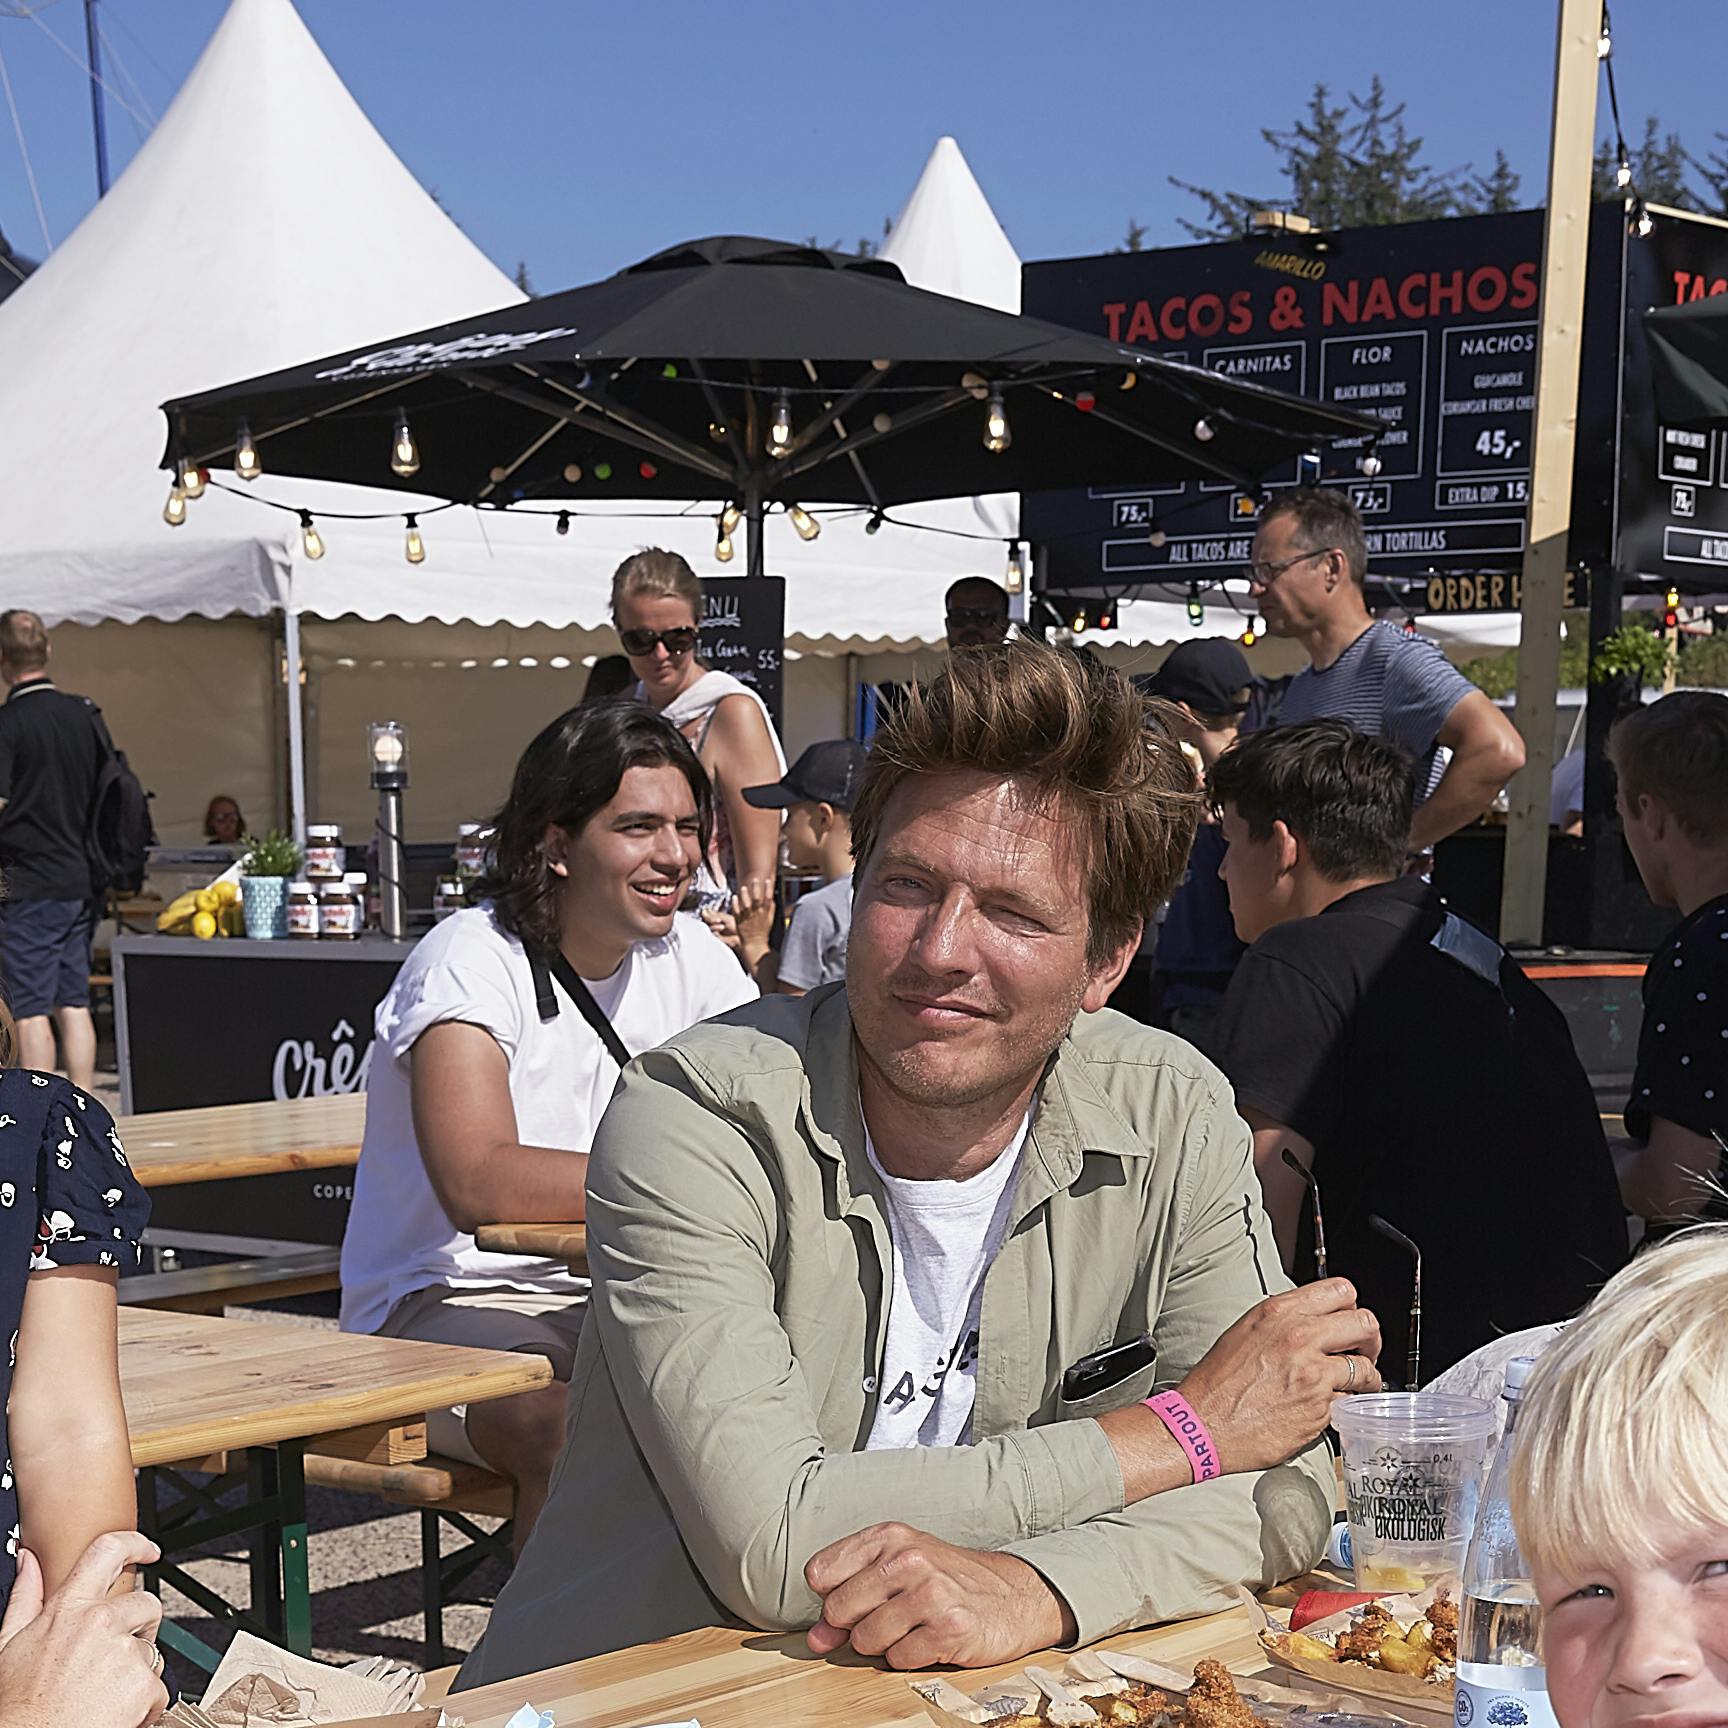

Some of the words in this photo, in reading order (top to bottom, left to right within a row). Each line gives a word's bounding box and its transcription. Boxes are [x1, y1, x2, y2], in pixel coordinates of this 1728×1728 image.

[1103, 290, 1253, 344] TACOS
[1269, 285, 1305, 332] &
[1322, 262, 1539, 327] NACHOS
[1352, 346, 1392, 365] FLOR
[1460, 334, 1535, 356] NACHOS
[1215, 354, 1292, 374] CARNITAS
[1475, 430, 1522, 459] 45,-
[1448, 486, 1479, 504] EXTRA
[1482, 485, 1498, 502] DIP
[1506, 482, 1529, 501] 15,
[1120, 504, 1147, 523] 75,-
[1169, 544, 1189, 563] ALL
[1190, 541, 1226, 562] TACOS
[1227, 539, 1250, 560] ARE
[1381, 529, 1447, 551] TORTILLAS
[1427, 575, 1504, 611] ORDER
[1511, 571, 1576, 611] HE
[313, 1184, 353, 1200] COPE
[1378, 1497, 1443, 1516] ROYAL
[1375, 1517, 1446, 1541] ØKOLOGISK
